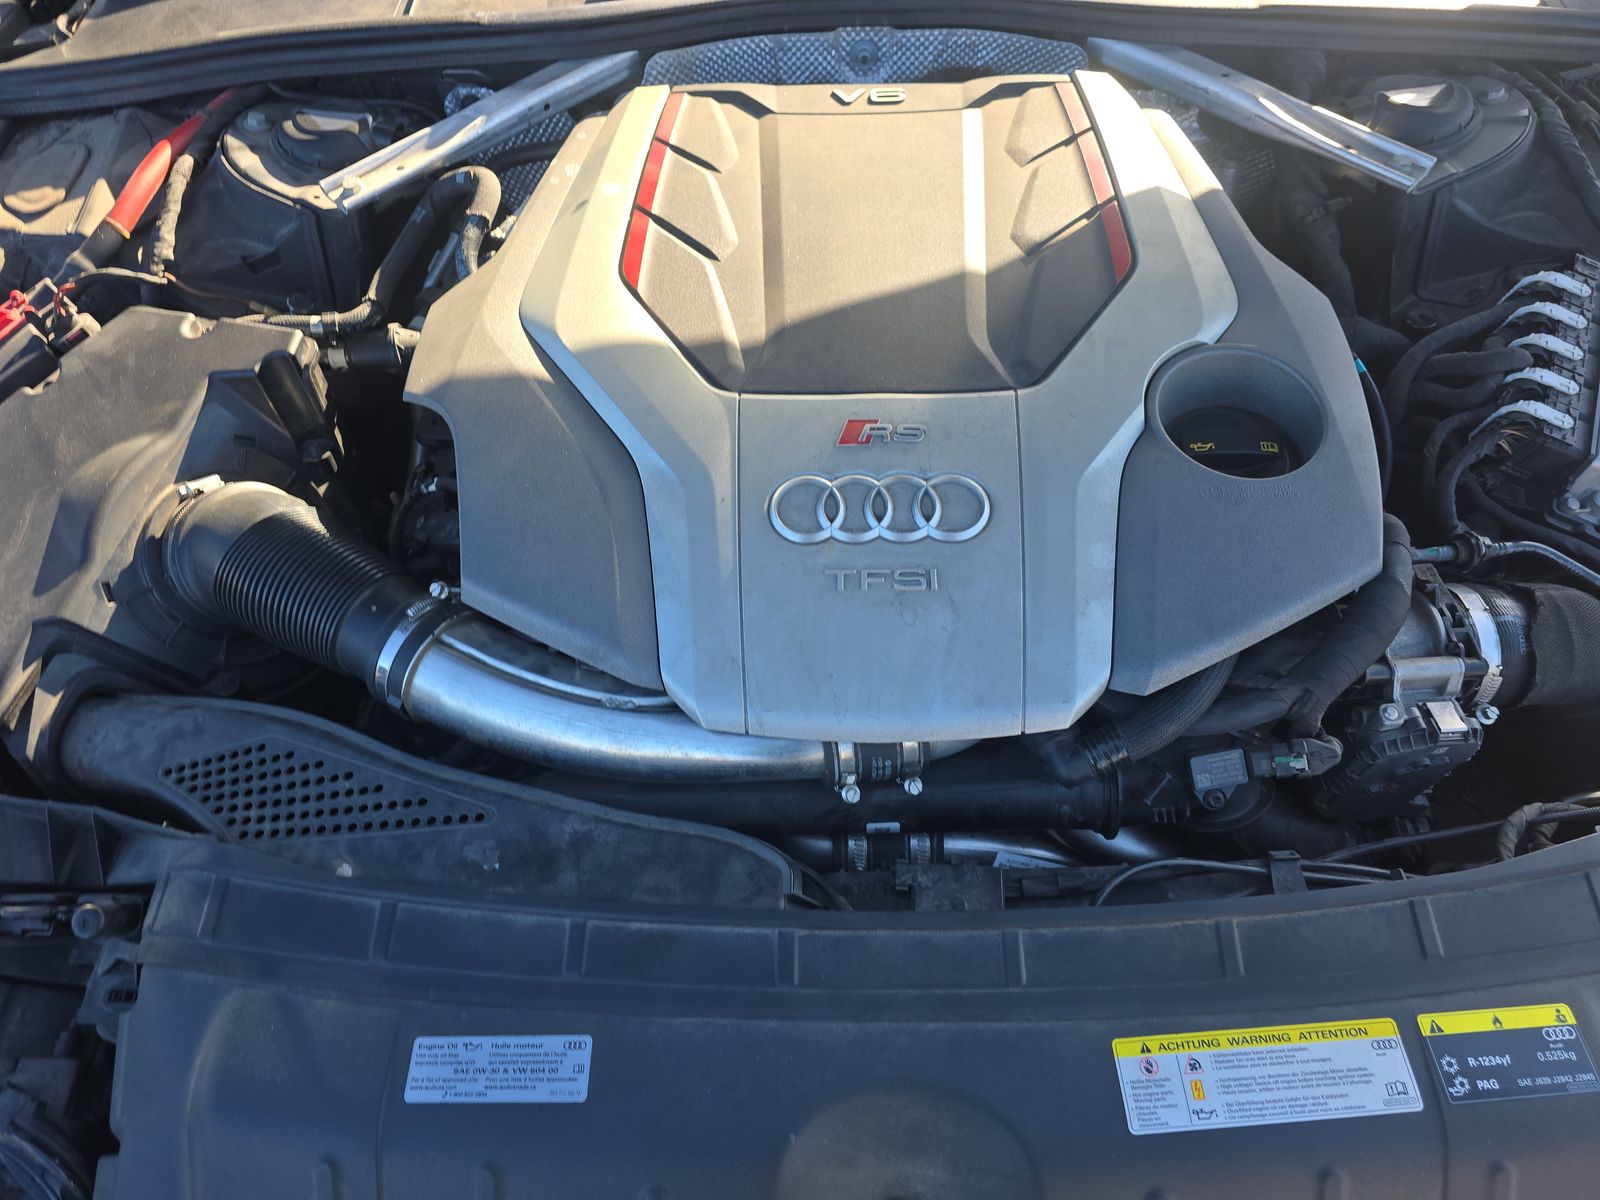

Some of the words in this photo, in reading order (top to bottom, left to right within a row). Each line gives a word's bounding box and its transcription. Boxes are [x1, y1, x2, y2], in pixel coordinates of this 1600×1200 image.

[832, 87, 906, 103] V6
[858, 424, 927, 443] RS
[825, 568, 938, 591] TFSI
[1158, 1038, 1220, 1052] ACHTUNG
[1227, 1032, 1291, 1046] WARNING
[1298, 1027, 1369, 1041] ATTENTION
[418, 1042, 444, 1051] Engine
[447, 1042, 458, 1050] Oil
[1467, 1054, 1512, 1068] R-1234yf
[1537, 1049, 1577, 1062] 0.525kg
[512, 1067, 528, 1075] VW
[1476, 1079, 1500, 1091] PAG
[1517, 1078, 1533, 1087] SAE
[1534, 1077, 1551, 1085] J639
[1553, 1075, 1574, 1083] J2842
